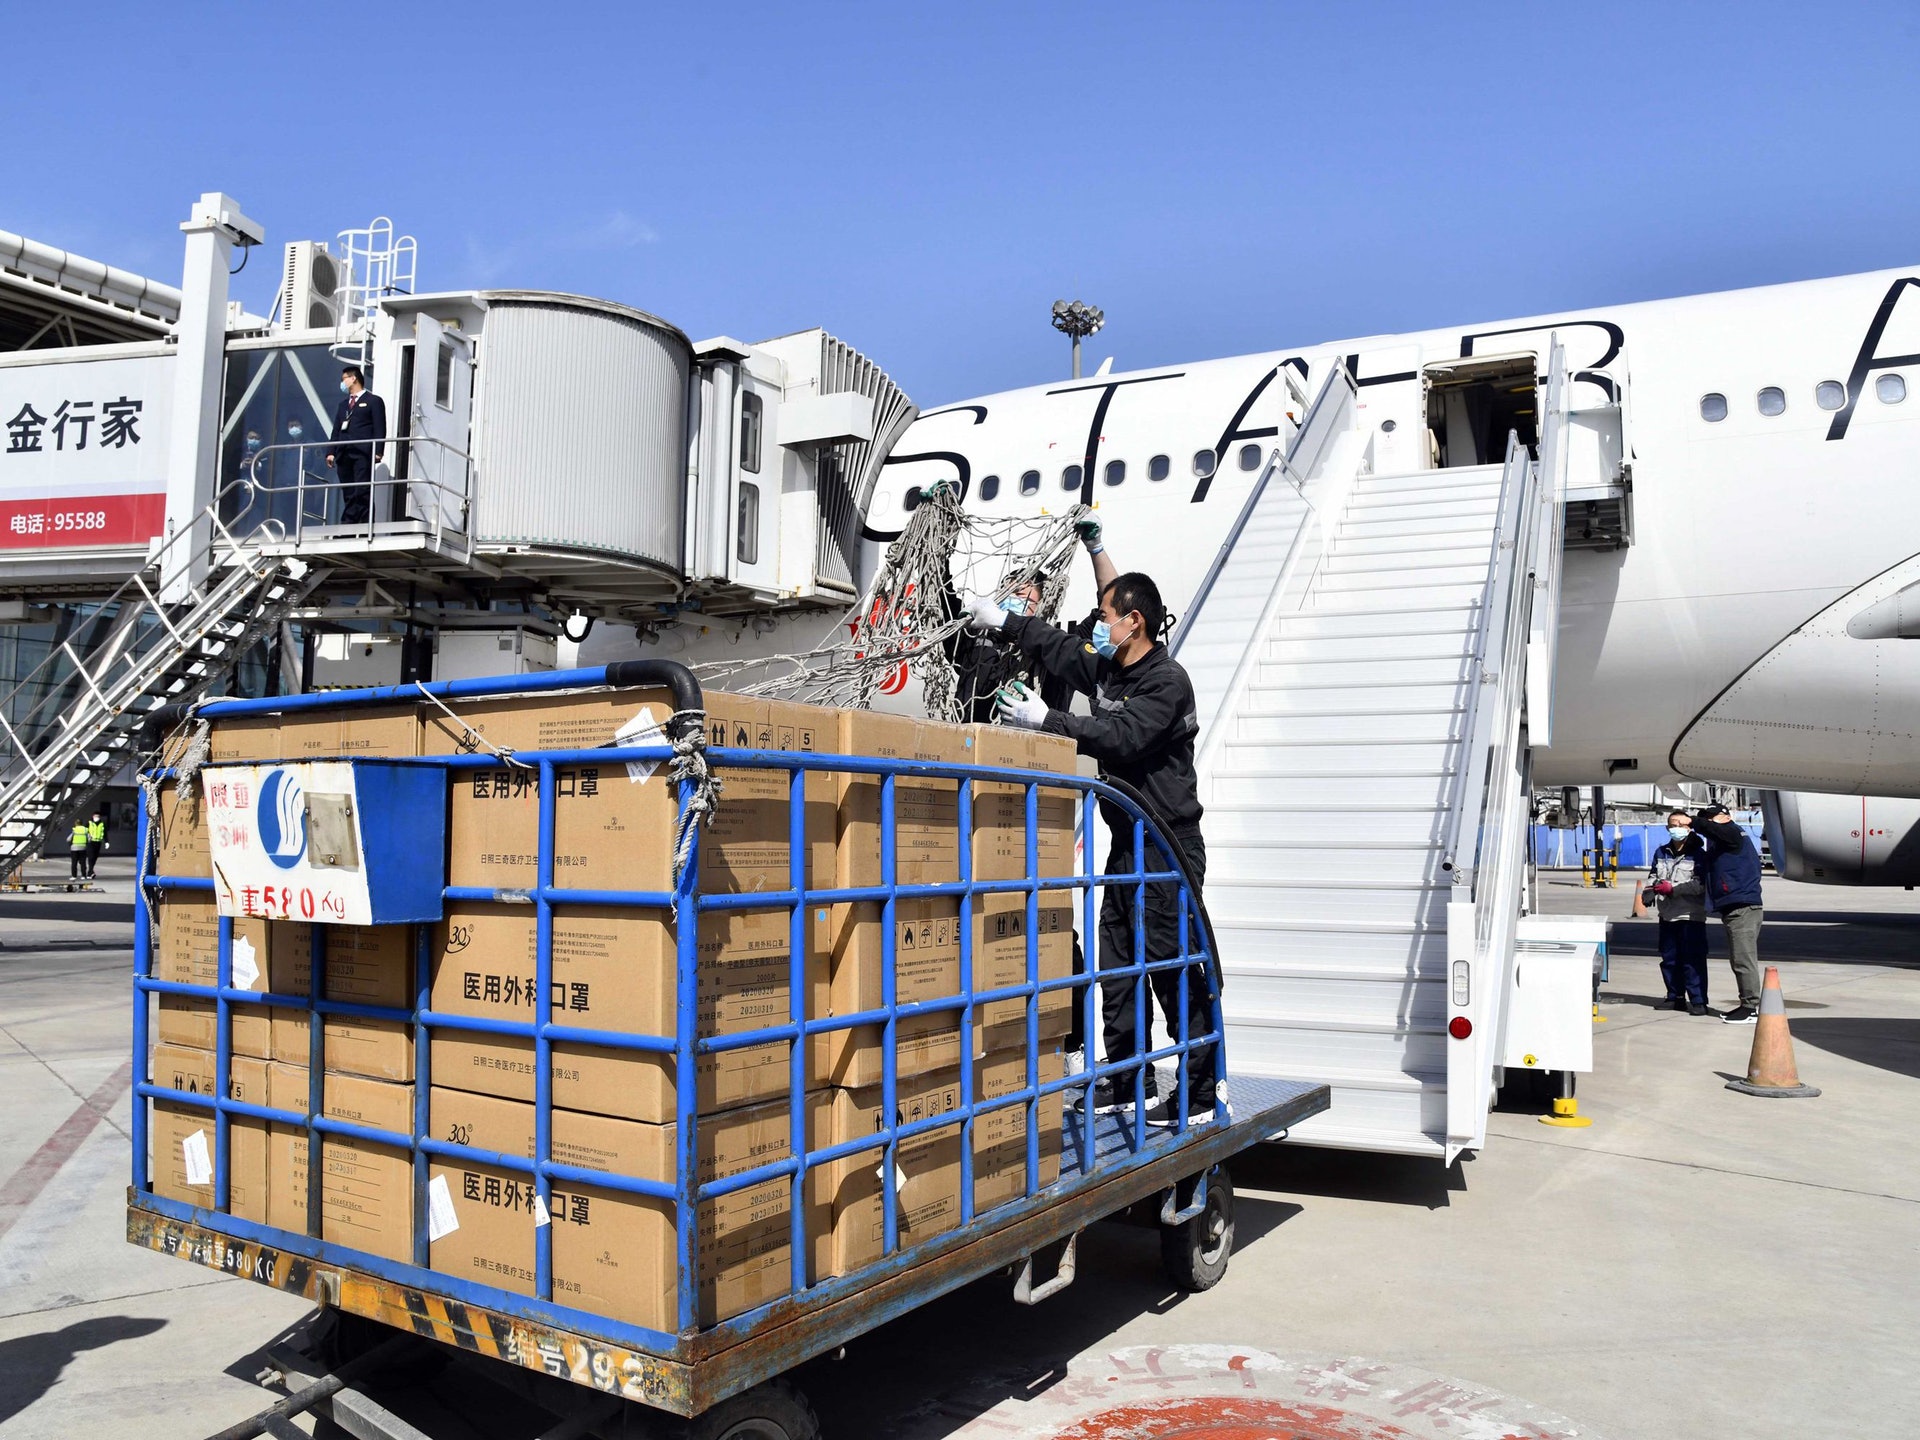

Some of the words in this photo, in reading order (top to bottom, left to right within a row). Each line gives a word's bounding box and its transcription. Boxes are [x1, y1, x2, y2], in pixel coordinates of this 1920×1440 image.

[6, 396, 143, 454] 金行家
[10, 511, 106, 534] 电话:95588
[473, 768, 599, 799] 医用外口罩
[481, 854, 587, 867] 日照三奇医疗卫生有限公司
[748, 939, 784, 950] 医用外科口罩
[474, 1257, 581, 1294] 日照三奇医疗卫生有限公司
